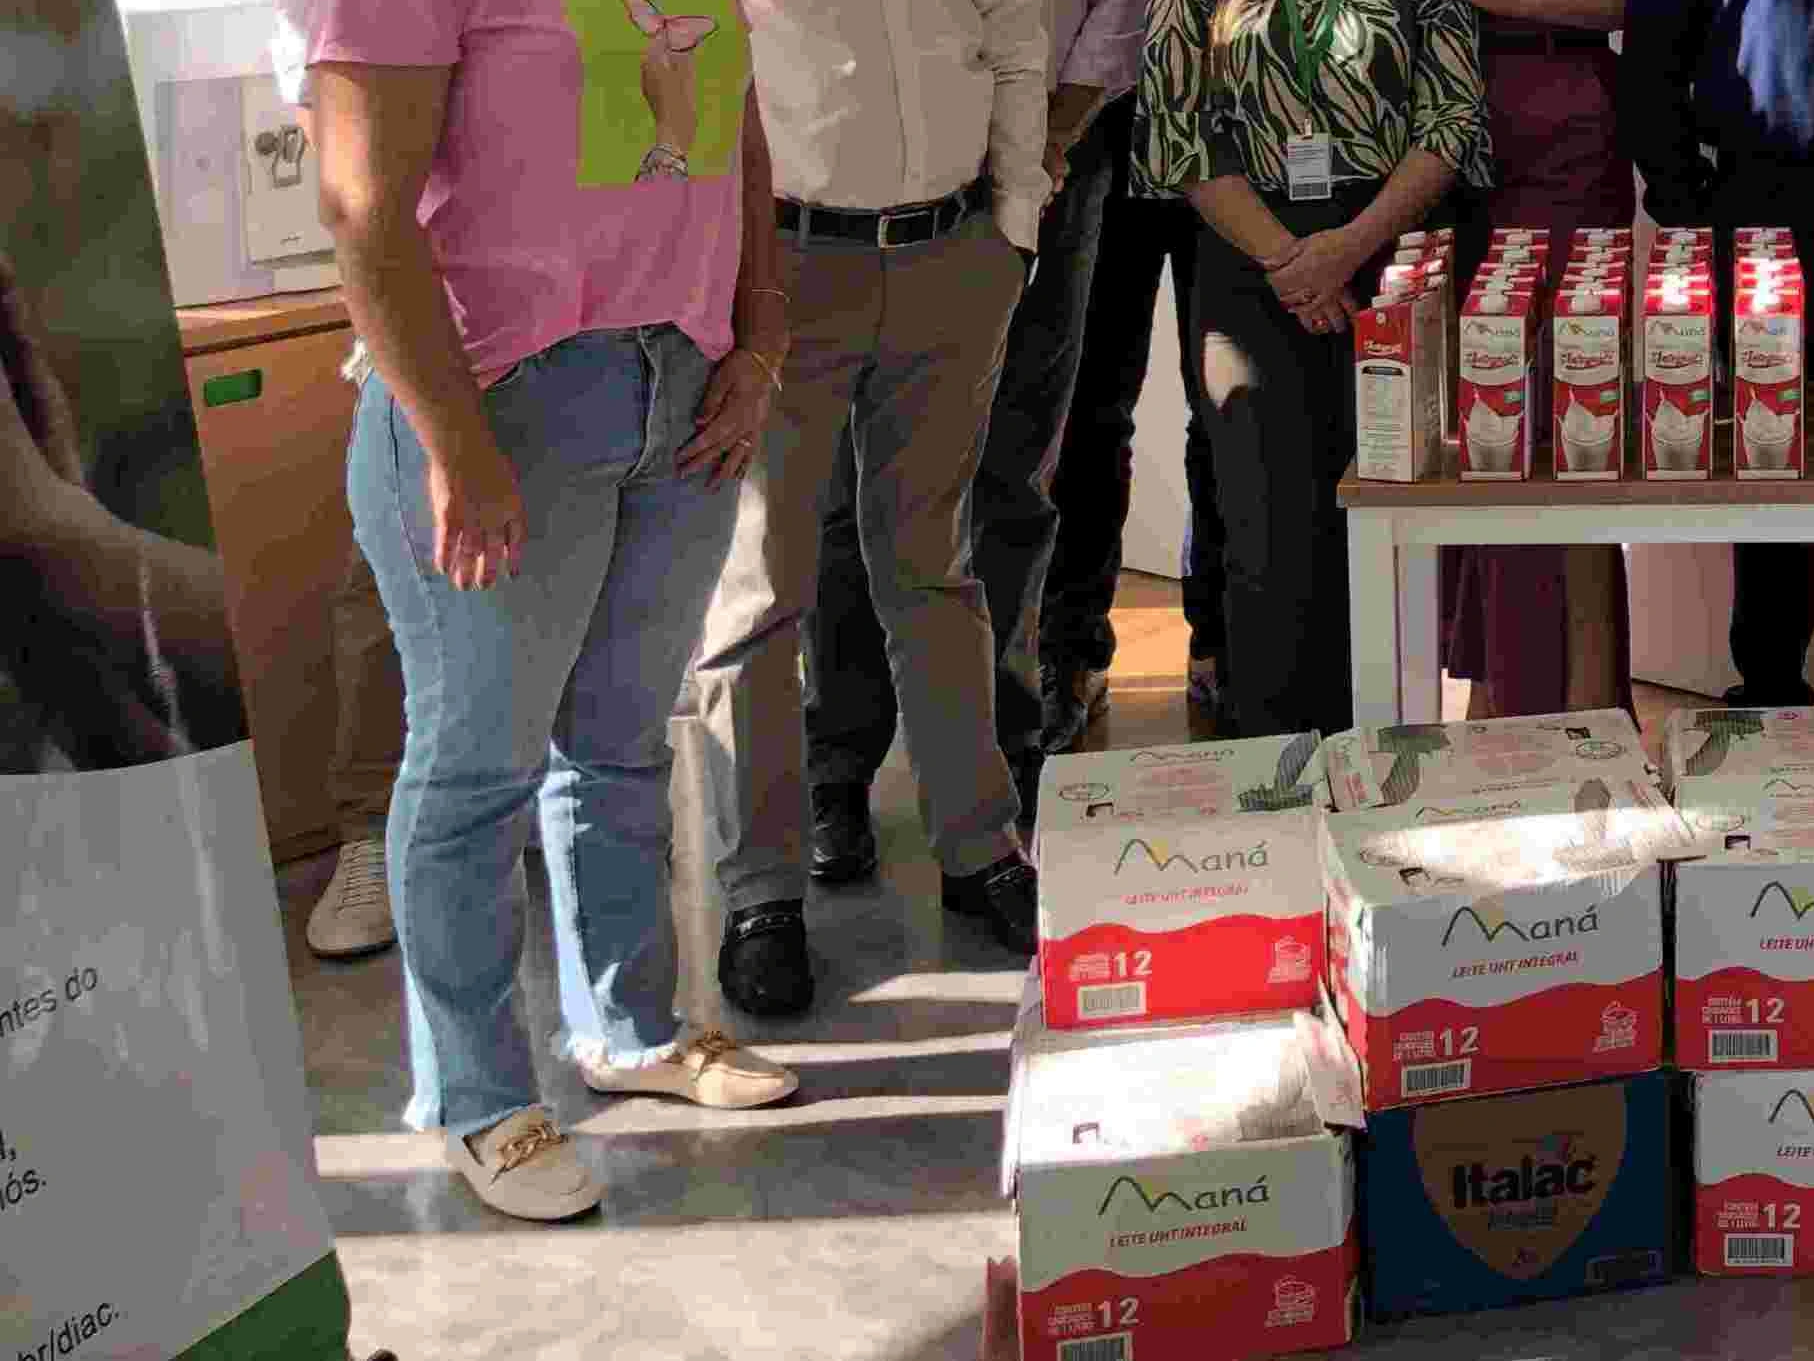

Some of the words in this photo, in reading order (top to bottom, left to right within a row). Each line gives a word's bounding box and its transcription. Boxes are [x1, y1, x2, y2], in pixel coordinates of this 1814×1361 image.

[1113, 838, 1268, 876] Maná
[1441, 904, 1600, 947] Maná
[1112, 950, 1153, 977] 12
[65, 966, 97, 1001] do
[1745, 997, 1785, 1026] 12
[1439, 1026, 1480, 1057] 12
[1098, 1174, 1270, 1216] Maná
[1453, 1150, 1599, 1209] Italac
[1761, 1203, 1801, 1230] 12
[1097, 1296, 1141, 1329] 12
